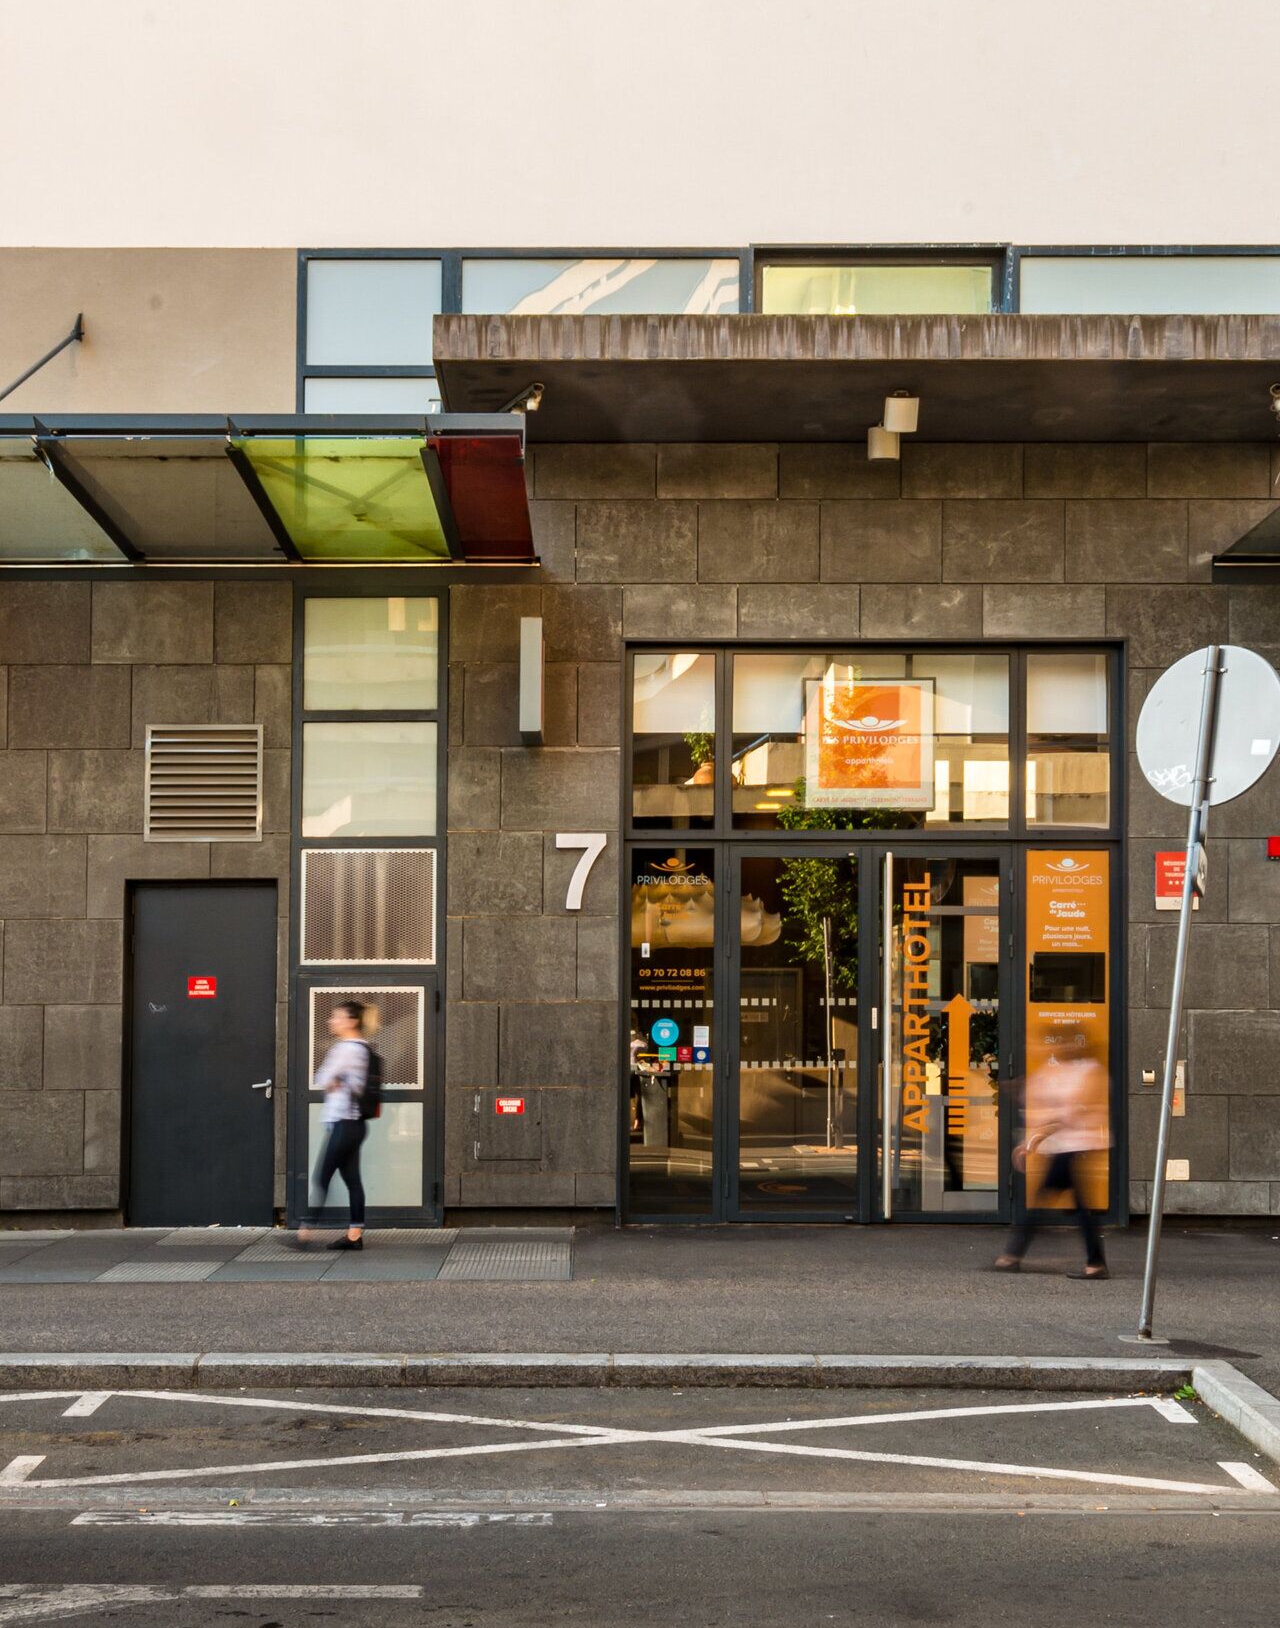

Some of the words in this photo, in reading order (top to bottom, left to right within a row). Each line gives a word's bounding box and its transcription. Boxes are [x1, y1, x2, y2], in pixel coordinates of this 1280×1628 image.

[843, 735, 919, 745] PRIVILODGES
[555, 833, 607, 910] 7
[637, 875, 709, 885] PRIVILODGES
[1032, 875, 1103, 885] PRIVILODGES
[1056, 910, 1086, 918] Jaude
[639, 968, 651, 977] 09
[653, 968, 665, 977] 70
[666, 968, 678, 977] 72
[679, 968, 692, 977] 08
[693, 968, 706, 977] 86
[896, 872, 931, 1133] APPARTHÔTEL
